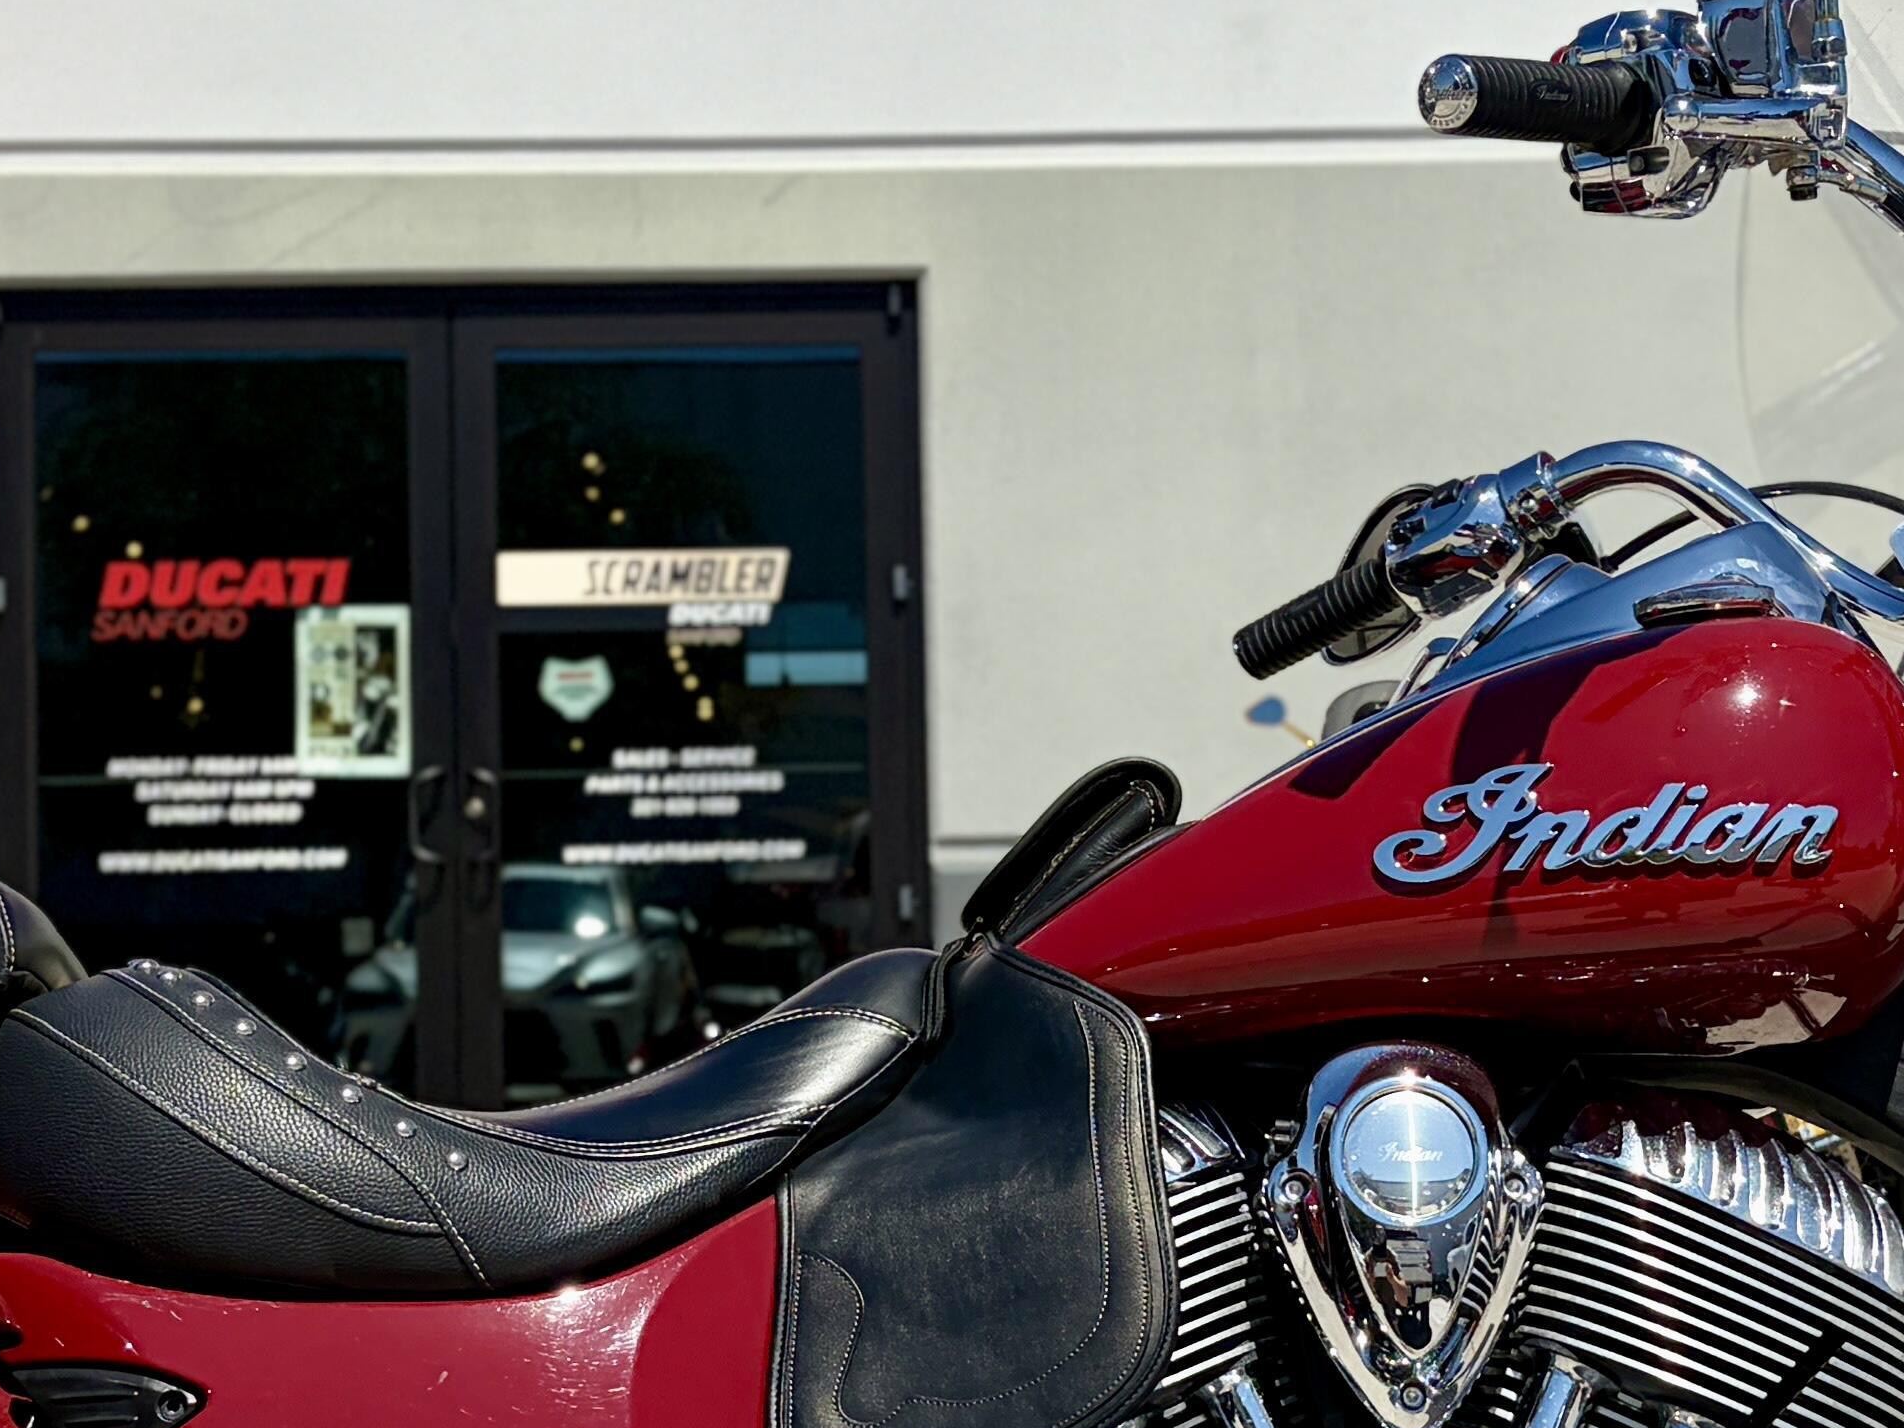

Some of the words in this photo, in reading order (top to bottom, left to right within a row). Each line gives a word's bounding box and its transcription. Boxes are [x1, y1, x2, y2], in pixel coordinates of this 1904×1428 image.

[99, 557, 351, 609] DUCATI
[583, 557, 778, 597] SCRAMBLER
[1373, 762, 1839, 884] Indian
